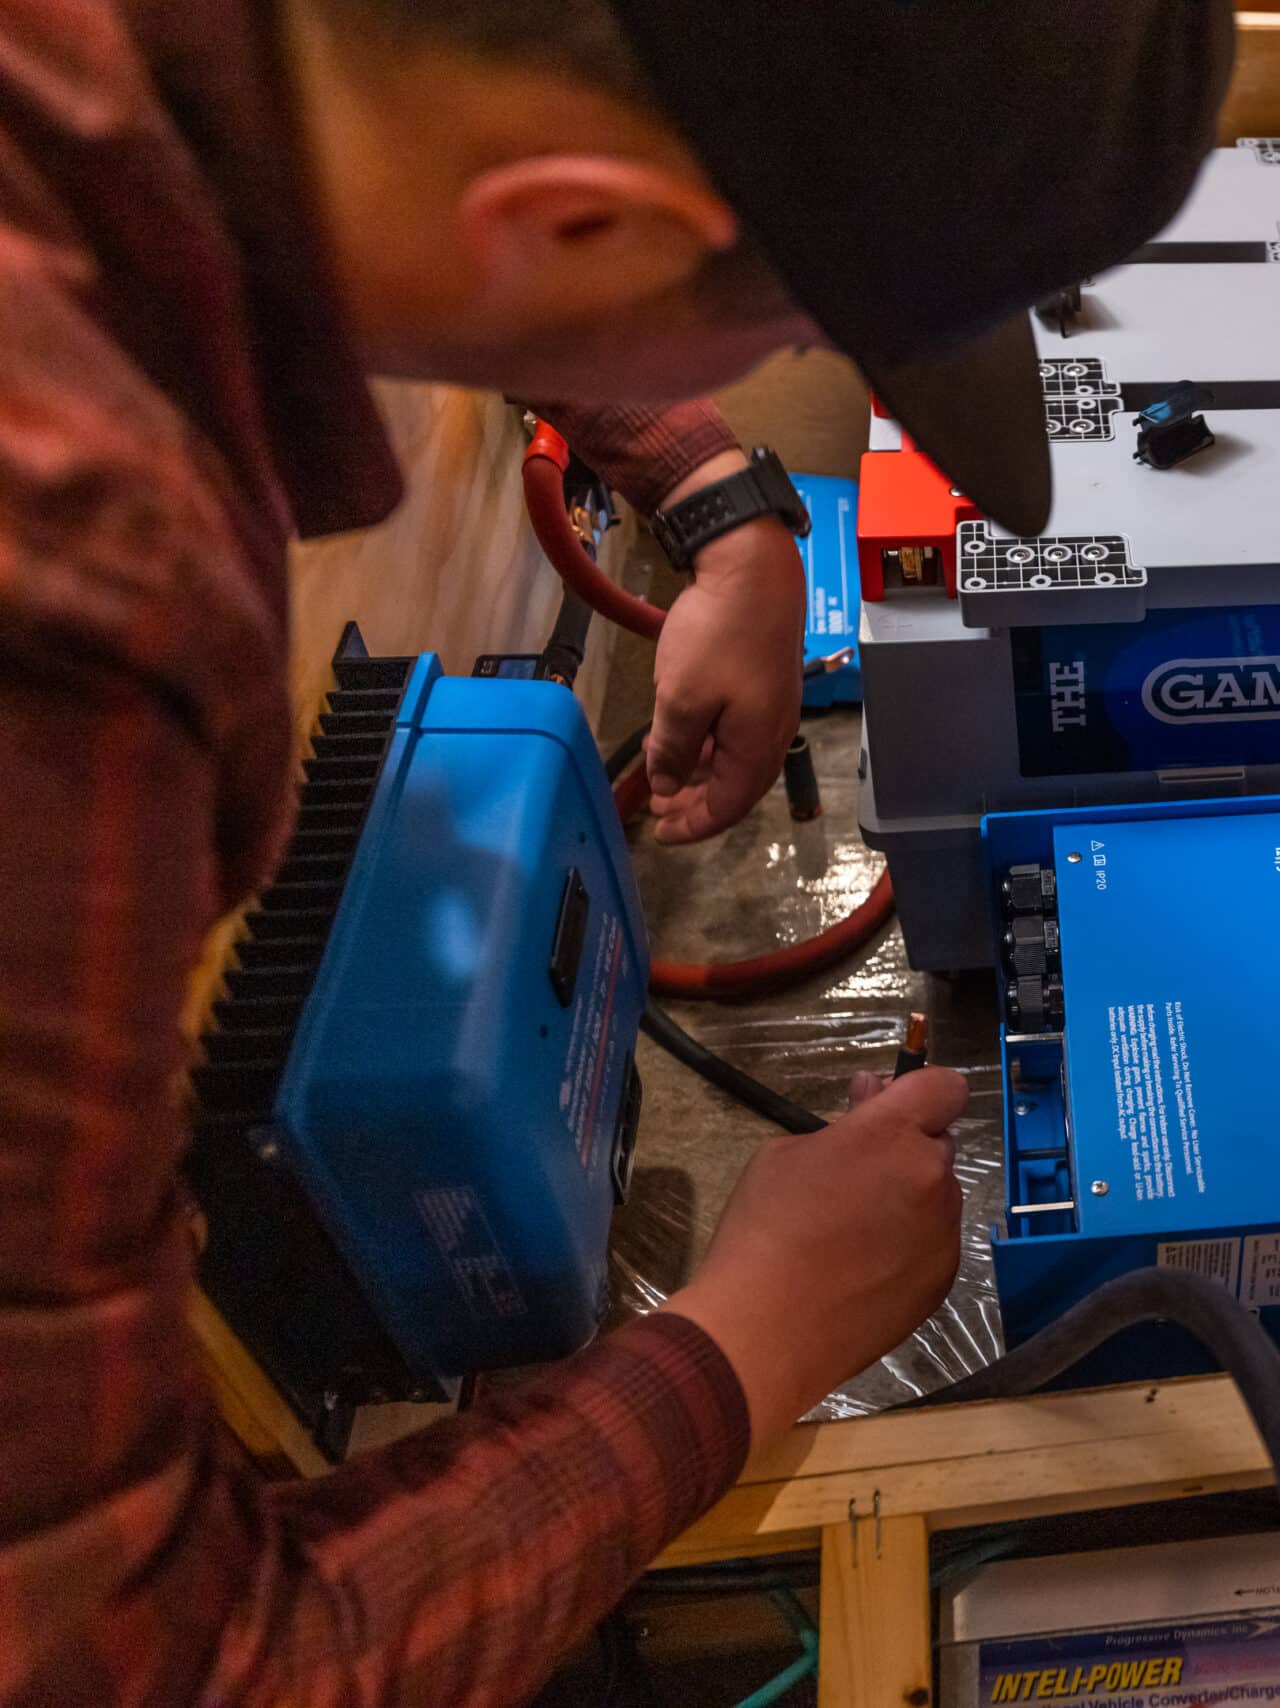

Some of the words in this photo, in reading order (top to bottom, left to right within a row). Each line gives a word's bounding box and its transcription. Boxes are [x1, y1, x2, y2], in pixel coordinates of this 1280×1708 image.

[1049, 661, 1087, 732] THE
[1095, 870, 1107, 890] IP20
[1105, 1632, 1171, 1646] Progressive
[992, 1656, 1184, 1704] INTELI-POWER
